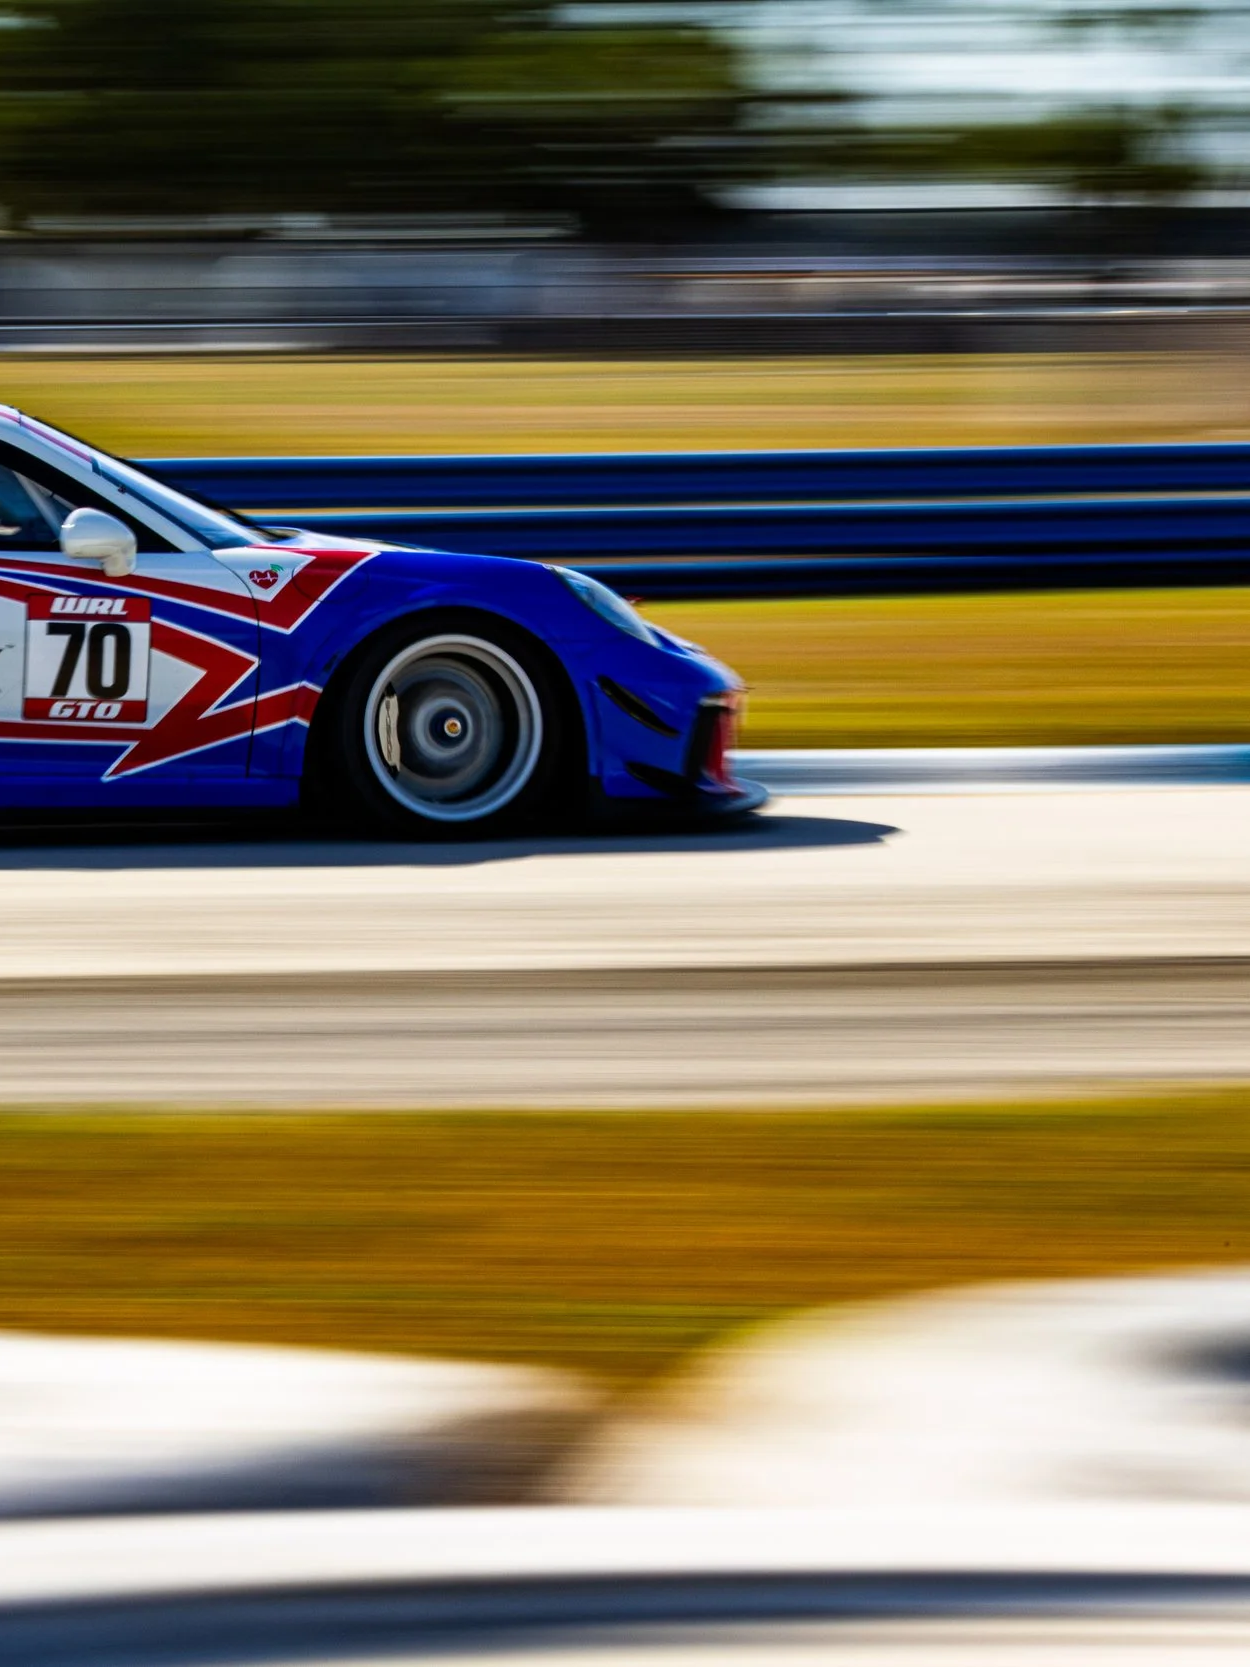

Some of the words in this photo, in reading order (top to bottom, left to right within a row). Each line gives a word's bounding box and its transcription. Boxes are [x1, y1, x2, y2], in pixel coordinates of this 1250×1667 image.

[50, 597, 128, 615] WRL
[46, 622, 131, 699] 70
[48, 700, 123, 719] GTO
